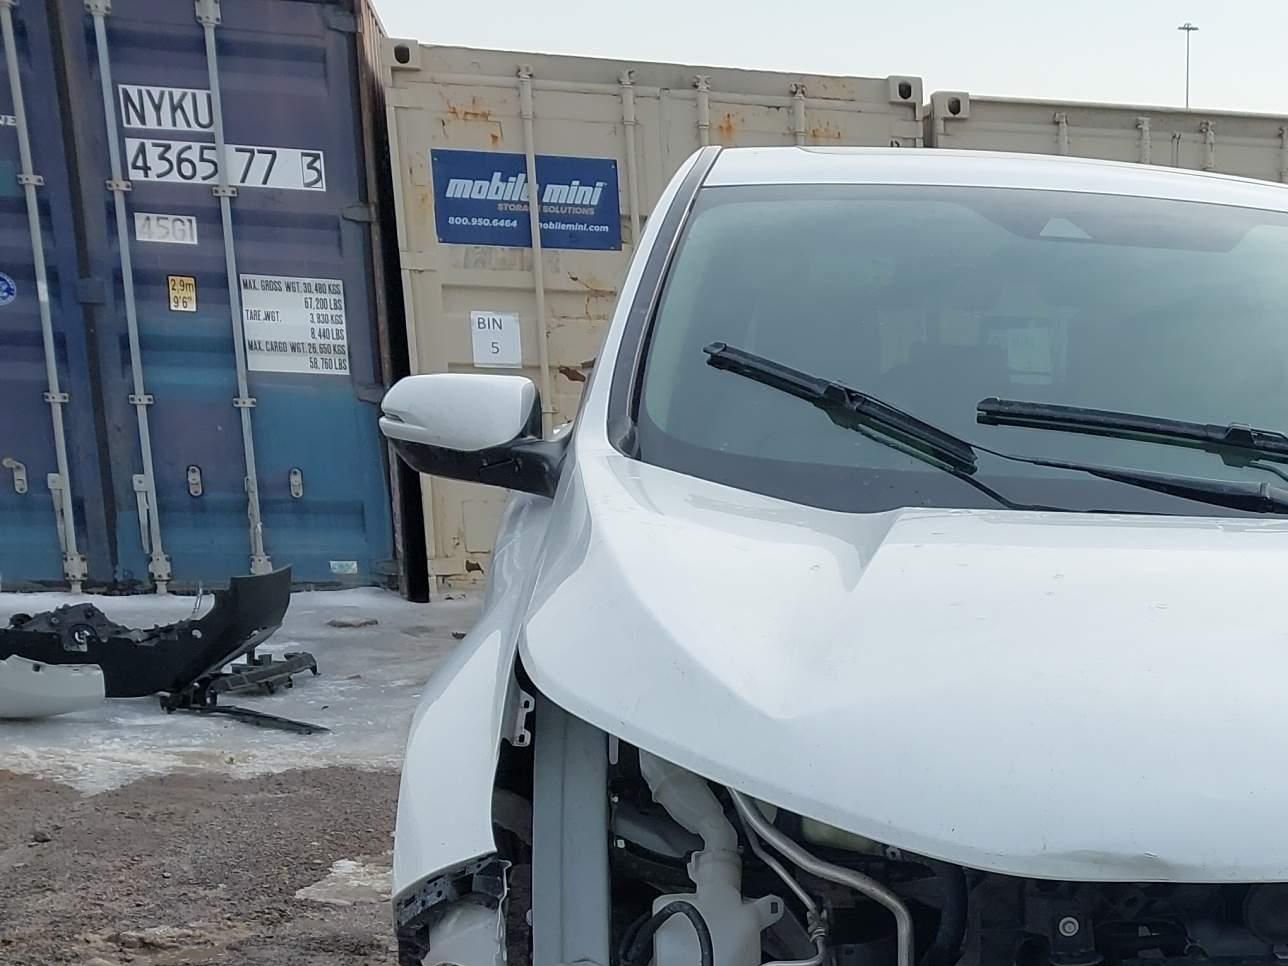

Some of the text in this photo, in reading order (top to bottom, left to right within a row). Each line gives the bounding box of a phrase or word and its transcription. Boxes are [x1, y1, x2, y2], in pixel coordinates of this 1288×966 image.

[121, 87, 215, 129] NYKU
[302, 152, 322, 188] 3
[542, 180, 605, 205] mini
[497, 203, 595, 216] STORA SOLUTIONS
[141, 216, 195, 242] 45G1
[538, 221, 609, 233] obilemini.com
[242, 279, 259, 291] MAX.
[260, 280, 283, 292] GROSS
[284, 281, 302, 293] WGT.
[328, 283, 341, 295] KGS
[329, 298, 343, 311] LBS
[330, 314, 344, 325] KGS
[477, 316, 503, 330] BIN
[331, 328, 345, 341] LBS
[247, 339, 264, 352] MAX.
[265, 340, 288, 353] CARGO
[289, 341, 307, 354] WGT.
[332, 344, 346, 356] KGS
[491, 341, 500, 354] 5
[334, 358, 347, 371] LBS
